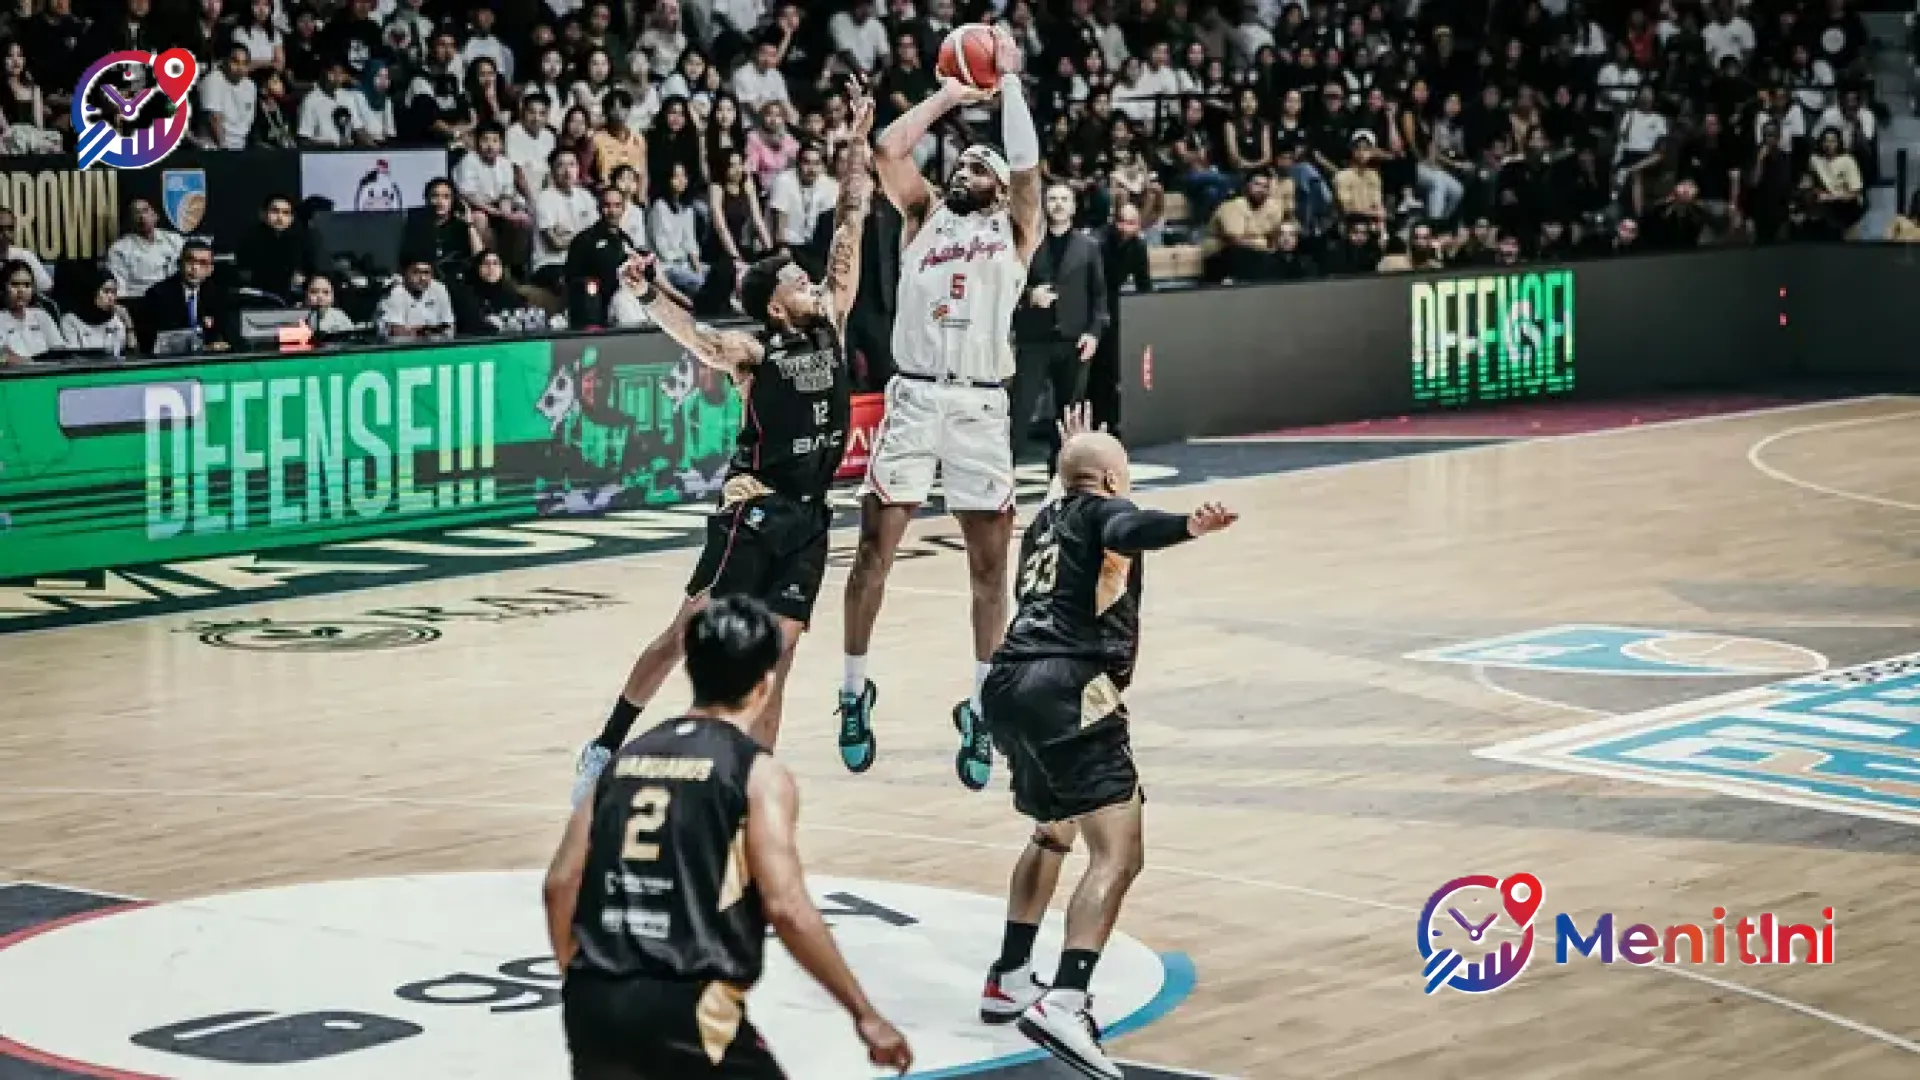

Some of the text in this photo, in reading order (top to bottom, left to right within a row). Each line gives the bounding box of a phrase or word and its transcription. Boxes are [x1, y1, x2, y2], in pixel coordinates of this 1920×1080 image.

[0, 171, 117, 260] ROWN
[950, 273, 967, 299] 5
[145, 361, 495, 541] DEFENSE!!!
[622, 786, 672, 861] 2
